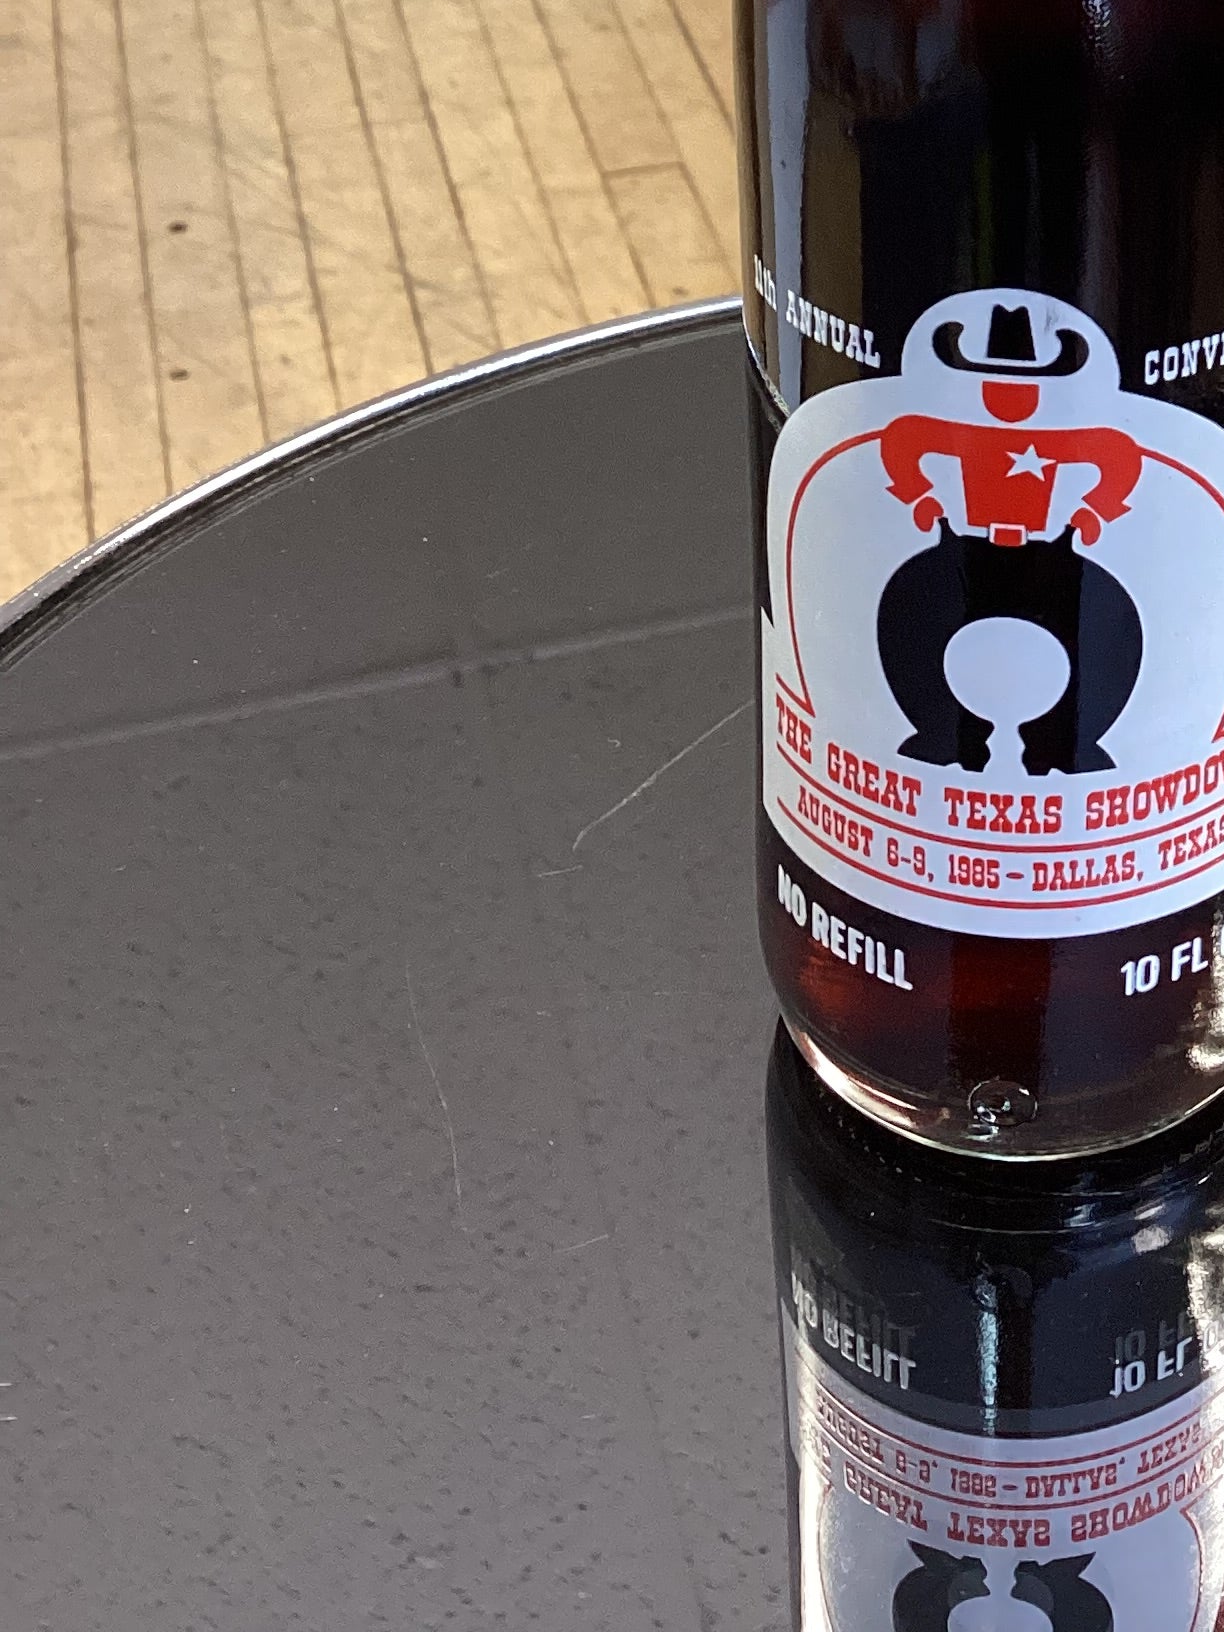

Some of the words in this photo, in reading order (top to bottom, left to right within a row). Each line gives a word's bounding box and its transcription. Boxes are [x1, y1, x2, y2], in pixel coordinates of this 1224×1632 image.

[785, 288, 881, 369] ANNUAL
[774, 691, 813, 766] THE
[826, 741, 922, 817] GREAT
[943, 786, 1063, 835] TEXAS
[798, 783, 874, 859] AUGUST
[776, 863, 808, 928] NO
[811, 901, 914, 992] REFILL
[1120, 955, 1160, 997] 10
[1171, 936, 1209, 982] FL
